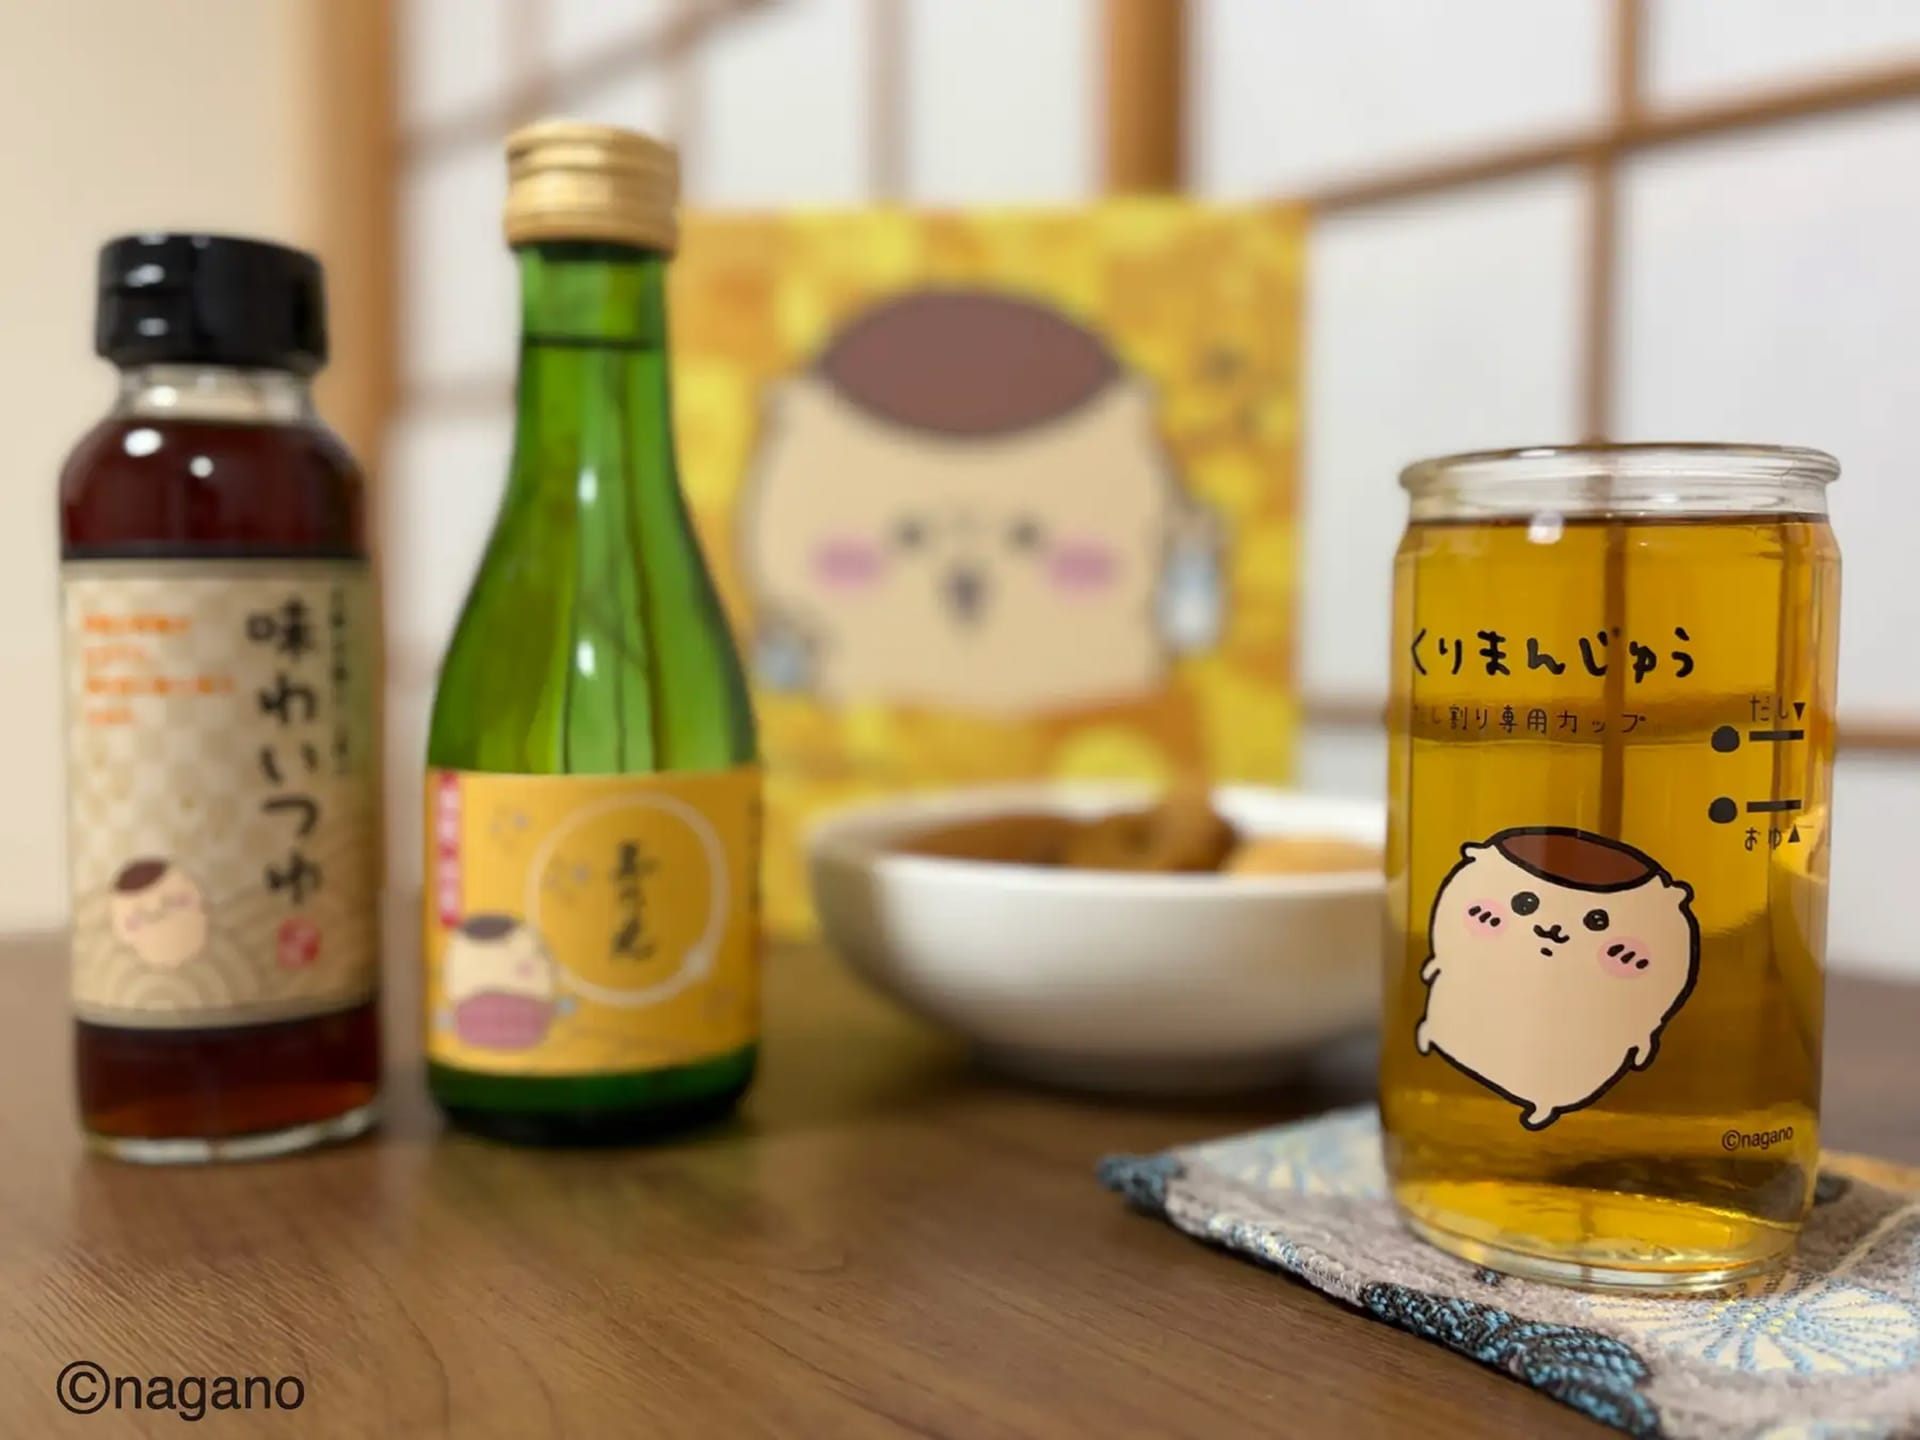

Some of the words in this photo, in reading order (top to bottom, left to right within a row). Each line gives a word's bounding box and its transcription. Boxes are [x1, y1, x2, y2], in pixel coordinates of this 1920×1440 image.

[1411, 627, 1695, 683] くりまんじゅう
[246, 594, 321, 904] 味わいつゆ
[1721, 1126, 1794, 1152] ©nagano
